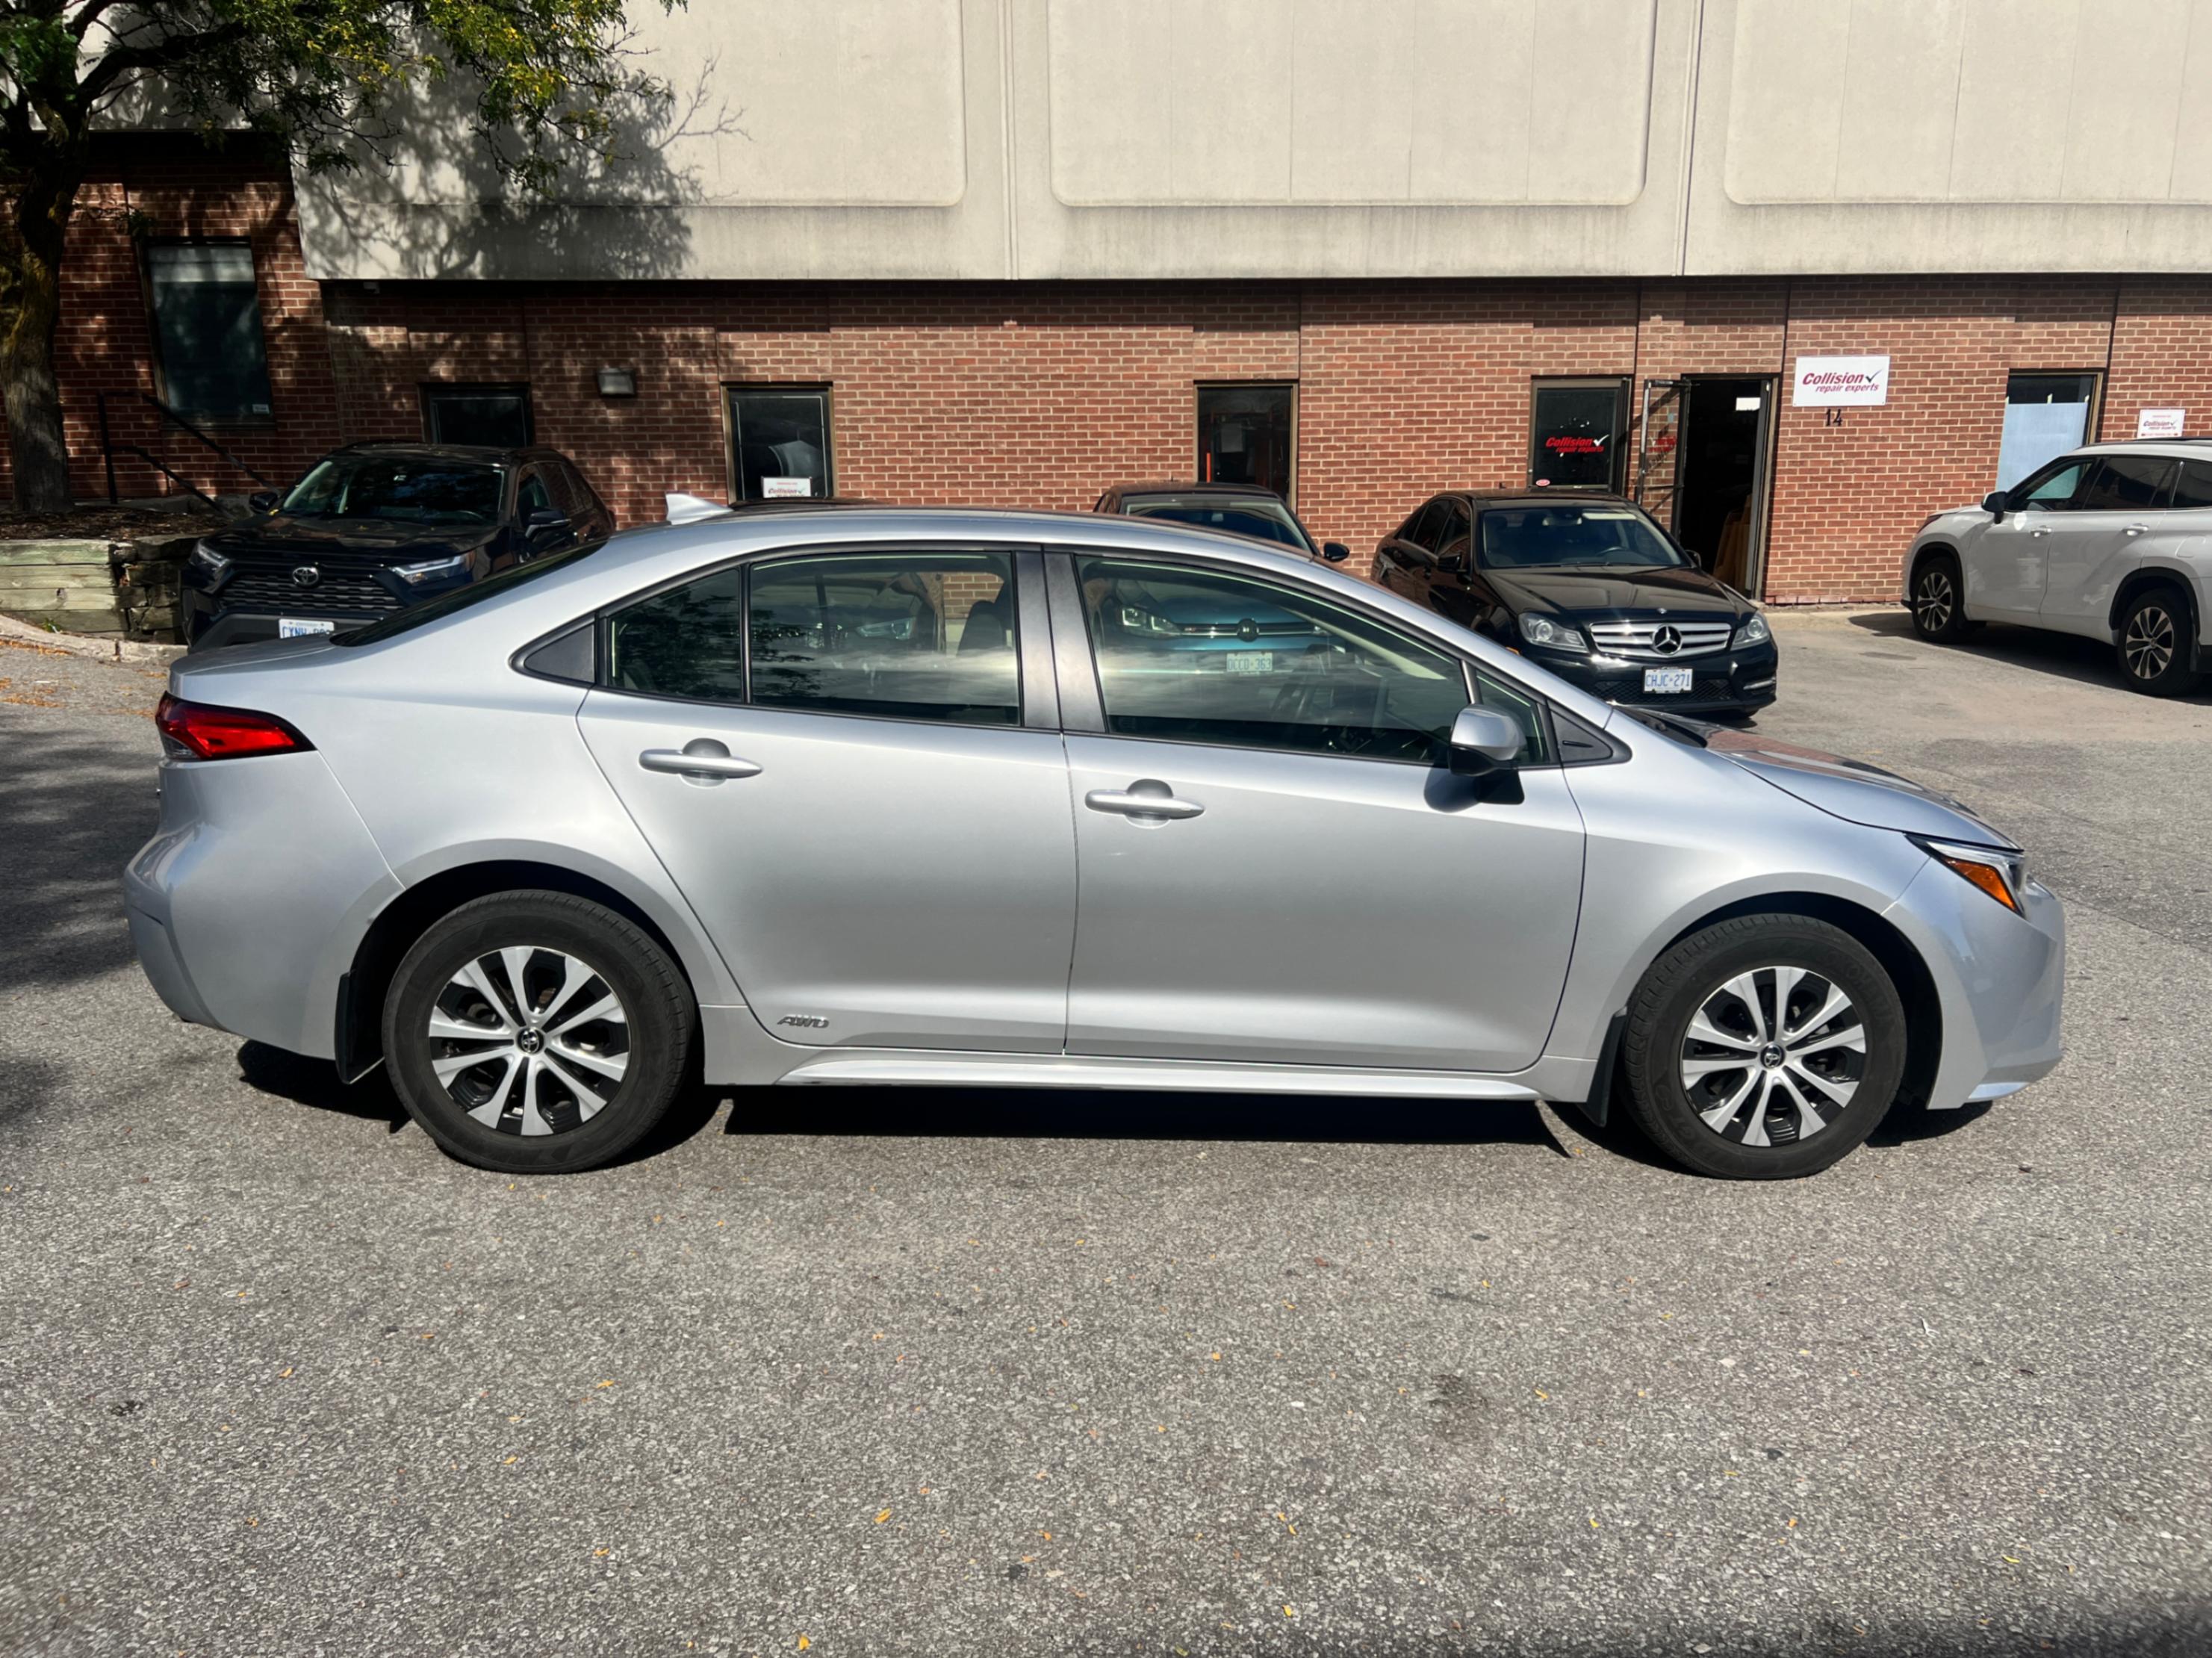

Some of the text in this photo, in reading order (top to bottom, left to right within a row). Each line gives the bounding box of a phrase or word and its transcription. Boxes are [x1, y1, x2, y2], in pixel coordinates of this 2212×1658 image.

[1802, 372, 1865, 385] Collision
[1815, 383, 1880, 394] repair experts
[1825, 408, 1843, 426] 14
[1545, 436, 1594, 447] Collision
[1645, 674, 1691, 687] CHJC 271
[777, 1014, 830, 1028] AWD
